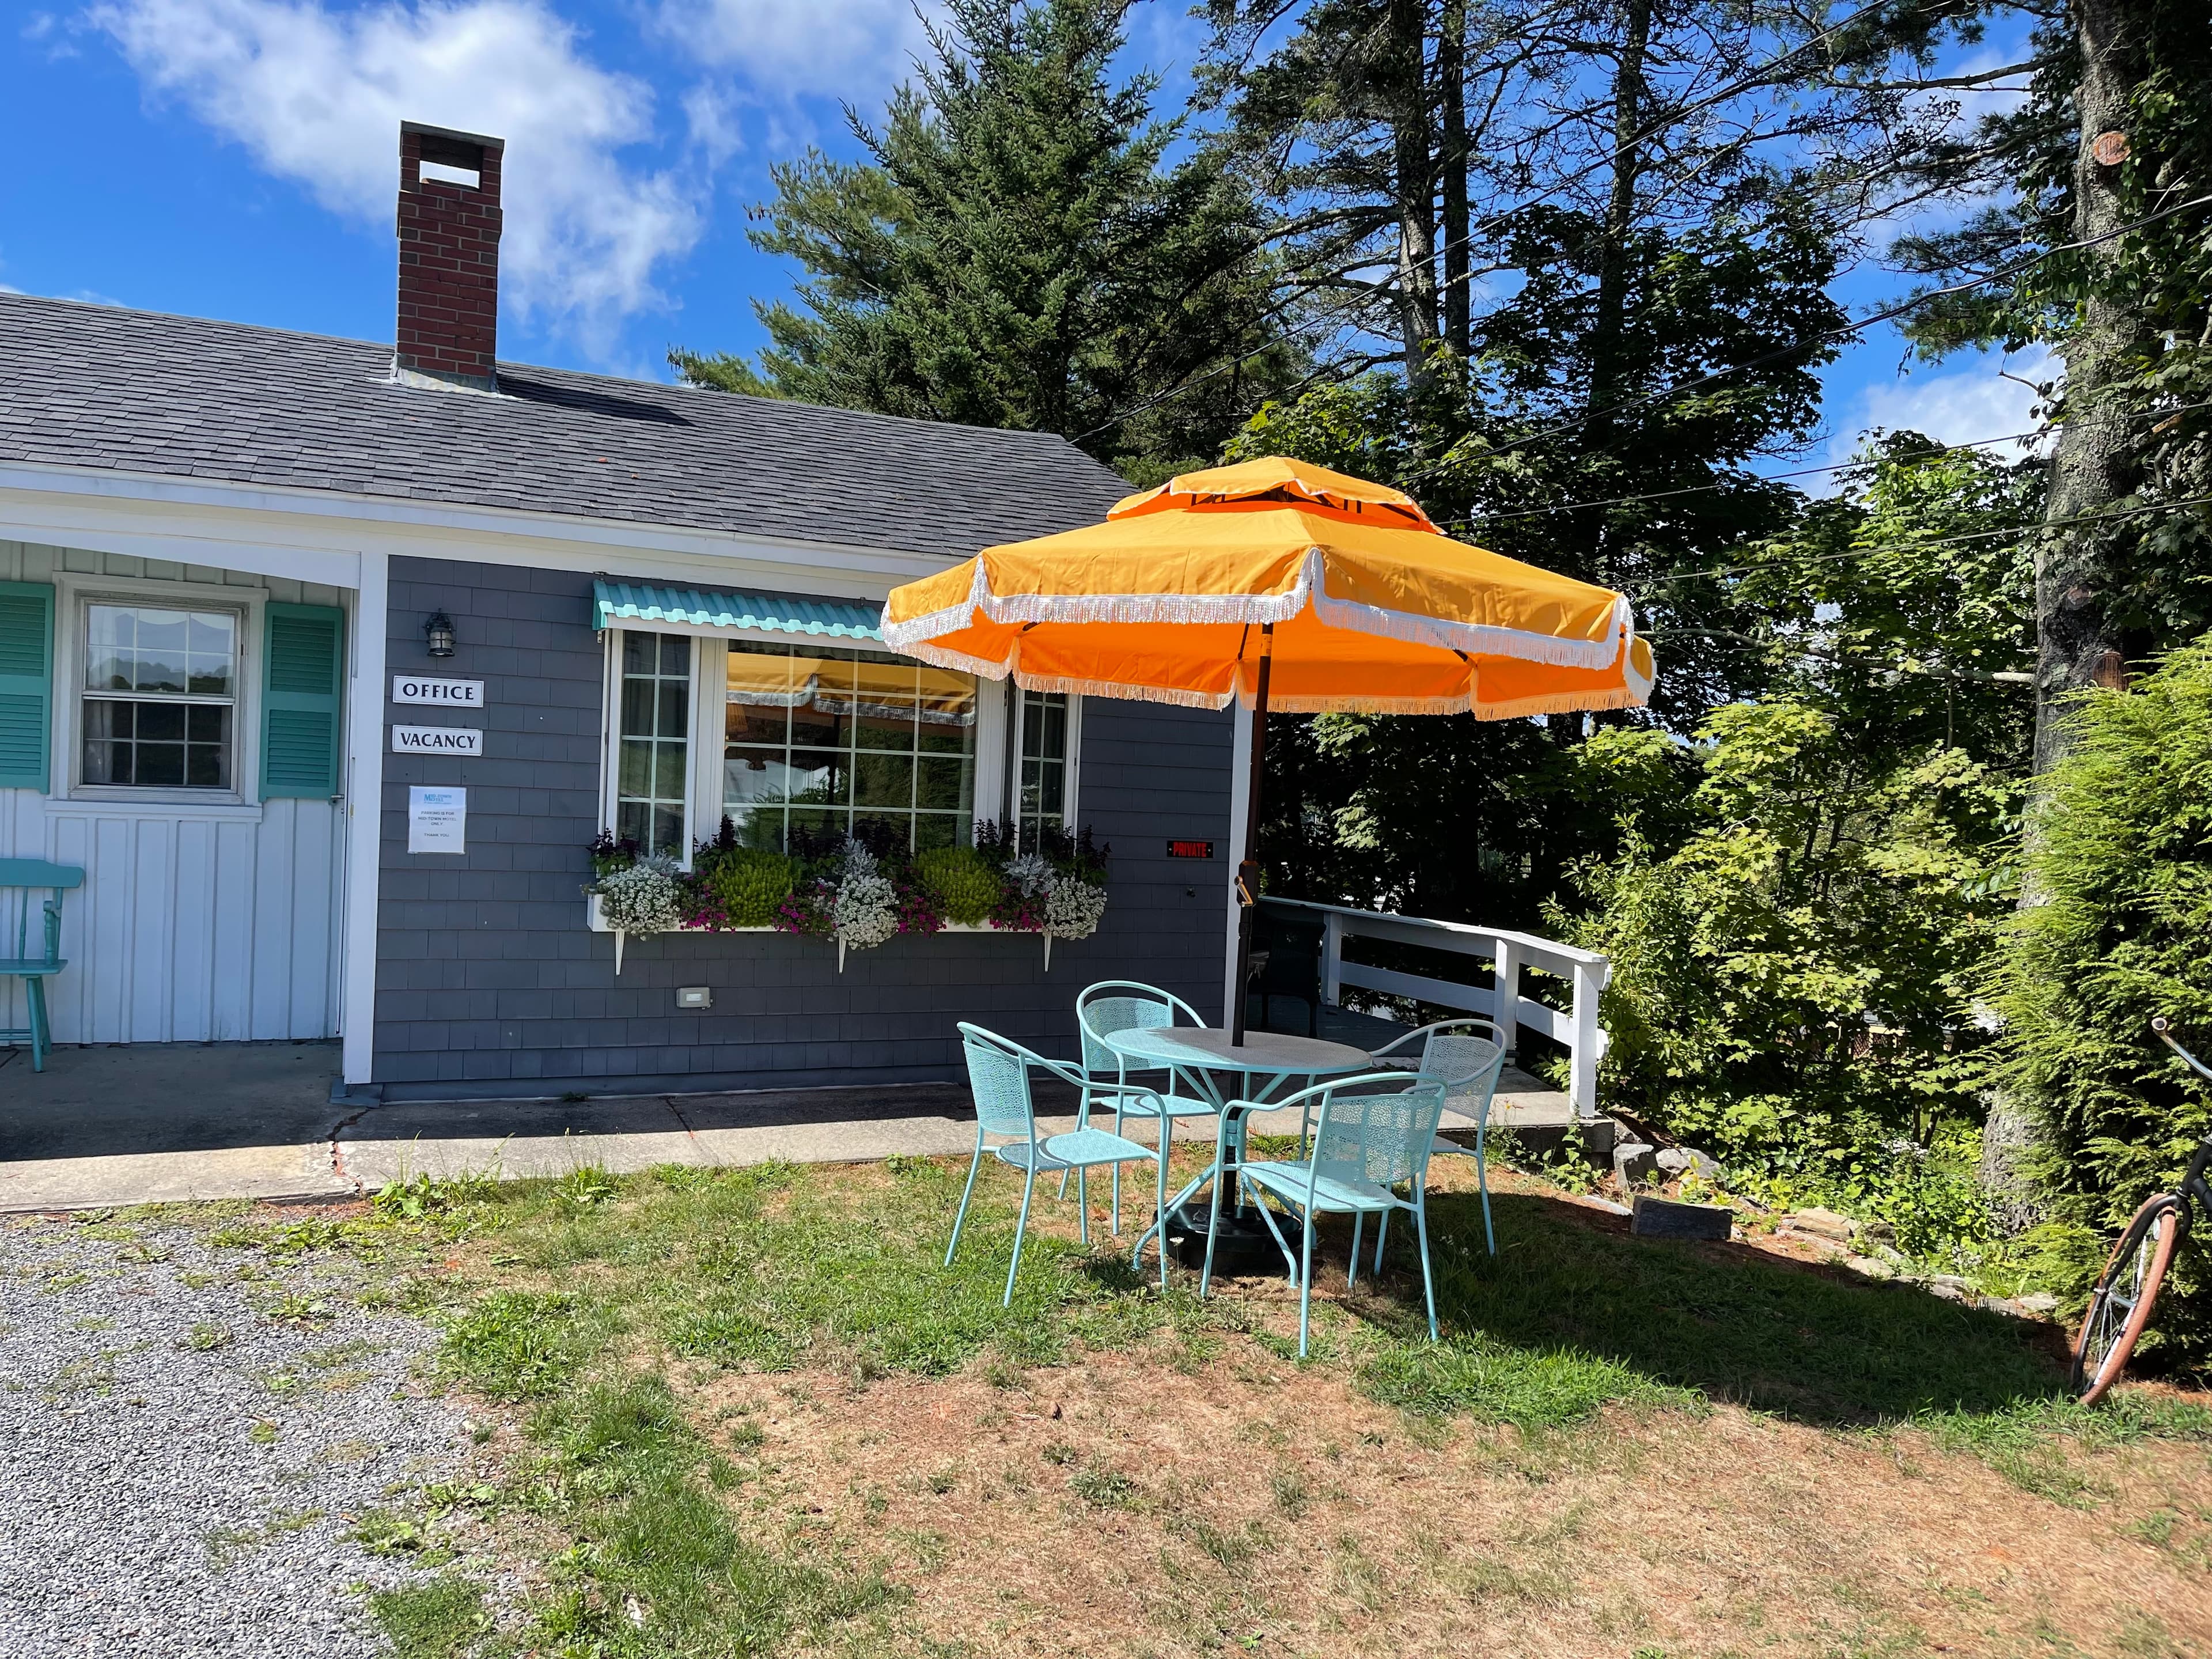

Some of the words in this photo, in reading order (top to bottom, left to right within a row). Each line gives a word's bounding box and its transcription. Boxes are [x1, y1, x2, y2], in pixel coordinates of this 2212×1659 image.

[403, 683, 474, 700] OFFICE
[400, 733, 475, 748] VACANCY
[1173, 841, 1207, 858] PRIVATE
